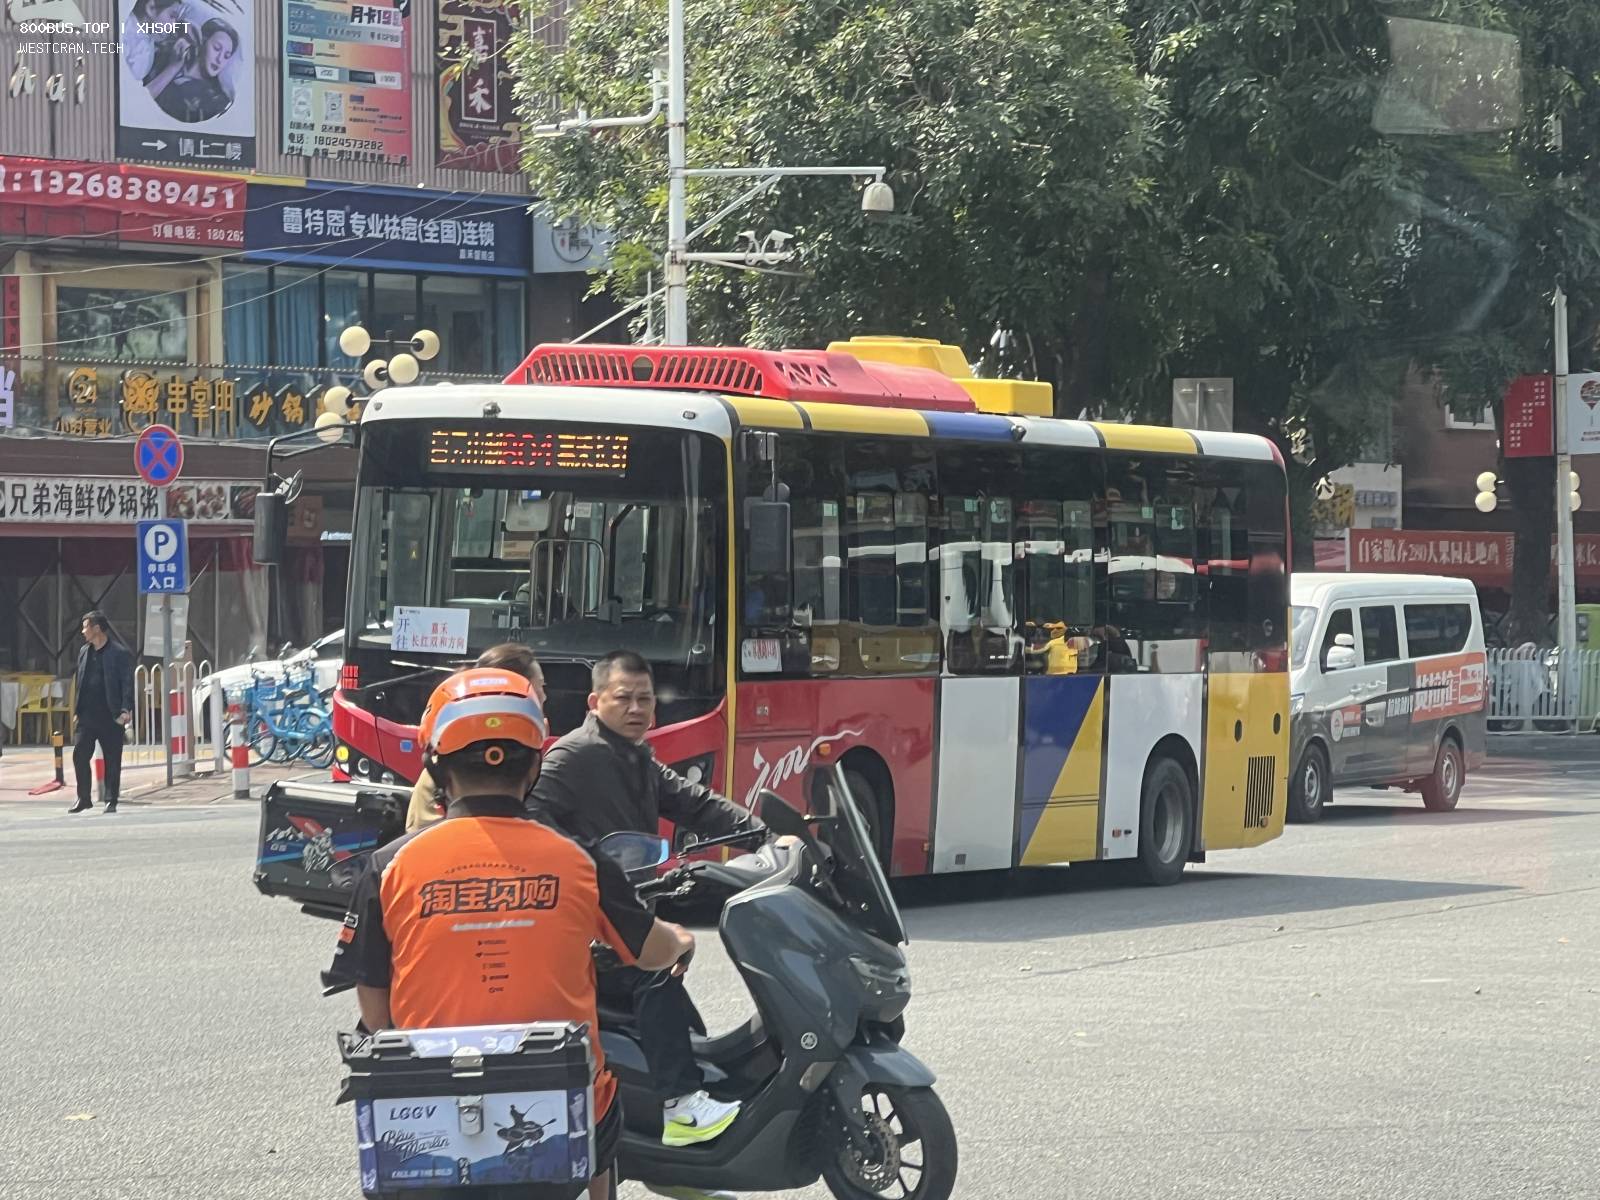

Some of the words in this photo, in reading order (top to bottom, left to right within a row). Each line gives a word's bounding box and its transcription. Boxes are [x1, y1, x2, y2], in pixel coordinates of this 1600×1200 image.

[468, 26, 493, 114] 嘉禾
[0, 164, 235, 209] :13268389451
[350, 211, 495, 246] 专业祛痘(全国)连锁
[9, 483, 160, 518] 兄弟海鲜砂锅粥
[149, 576, 175, 589] 入口
[421, 875, 560, 918] 淘宝闪购
